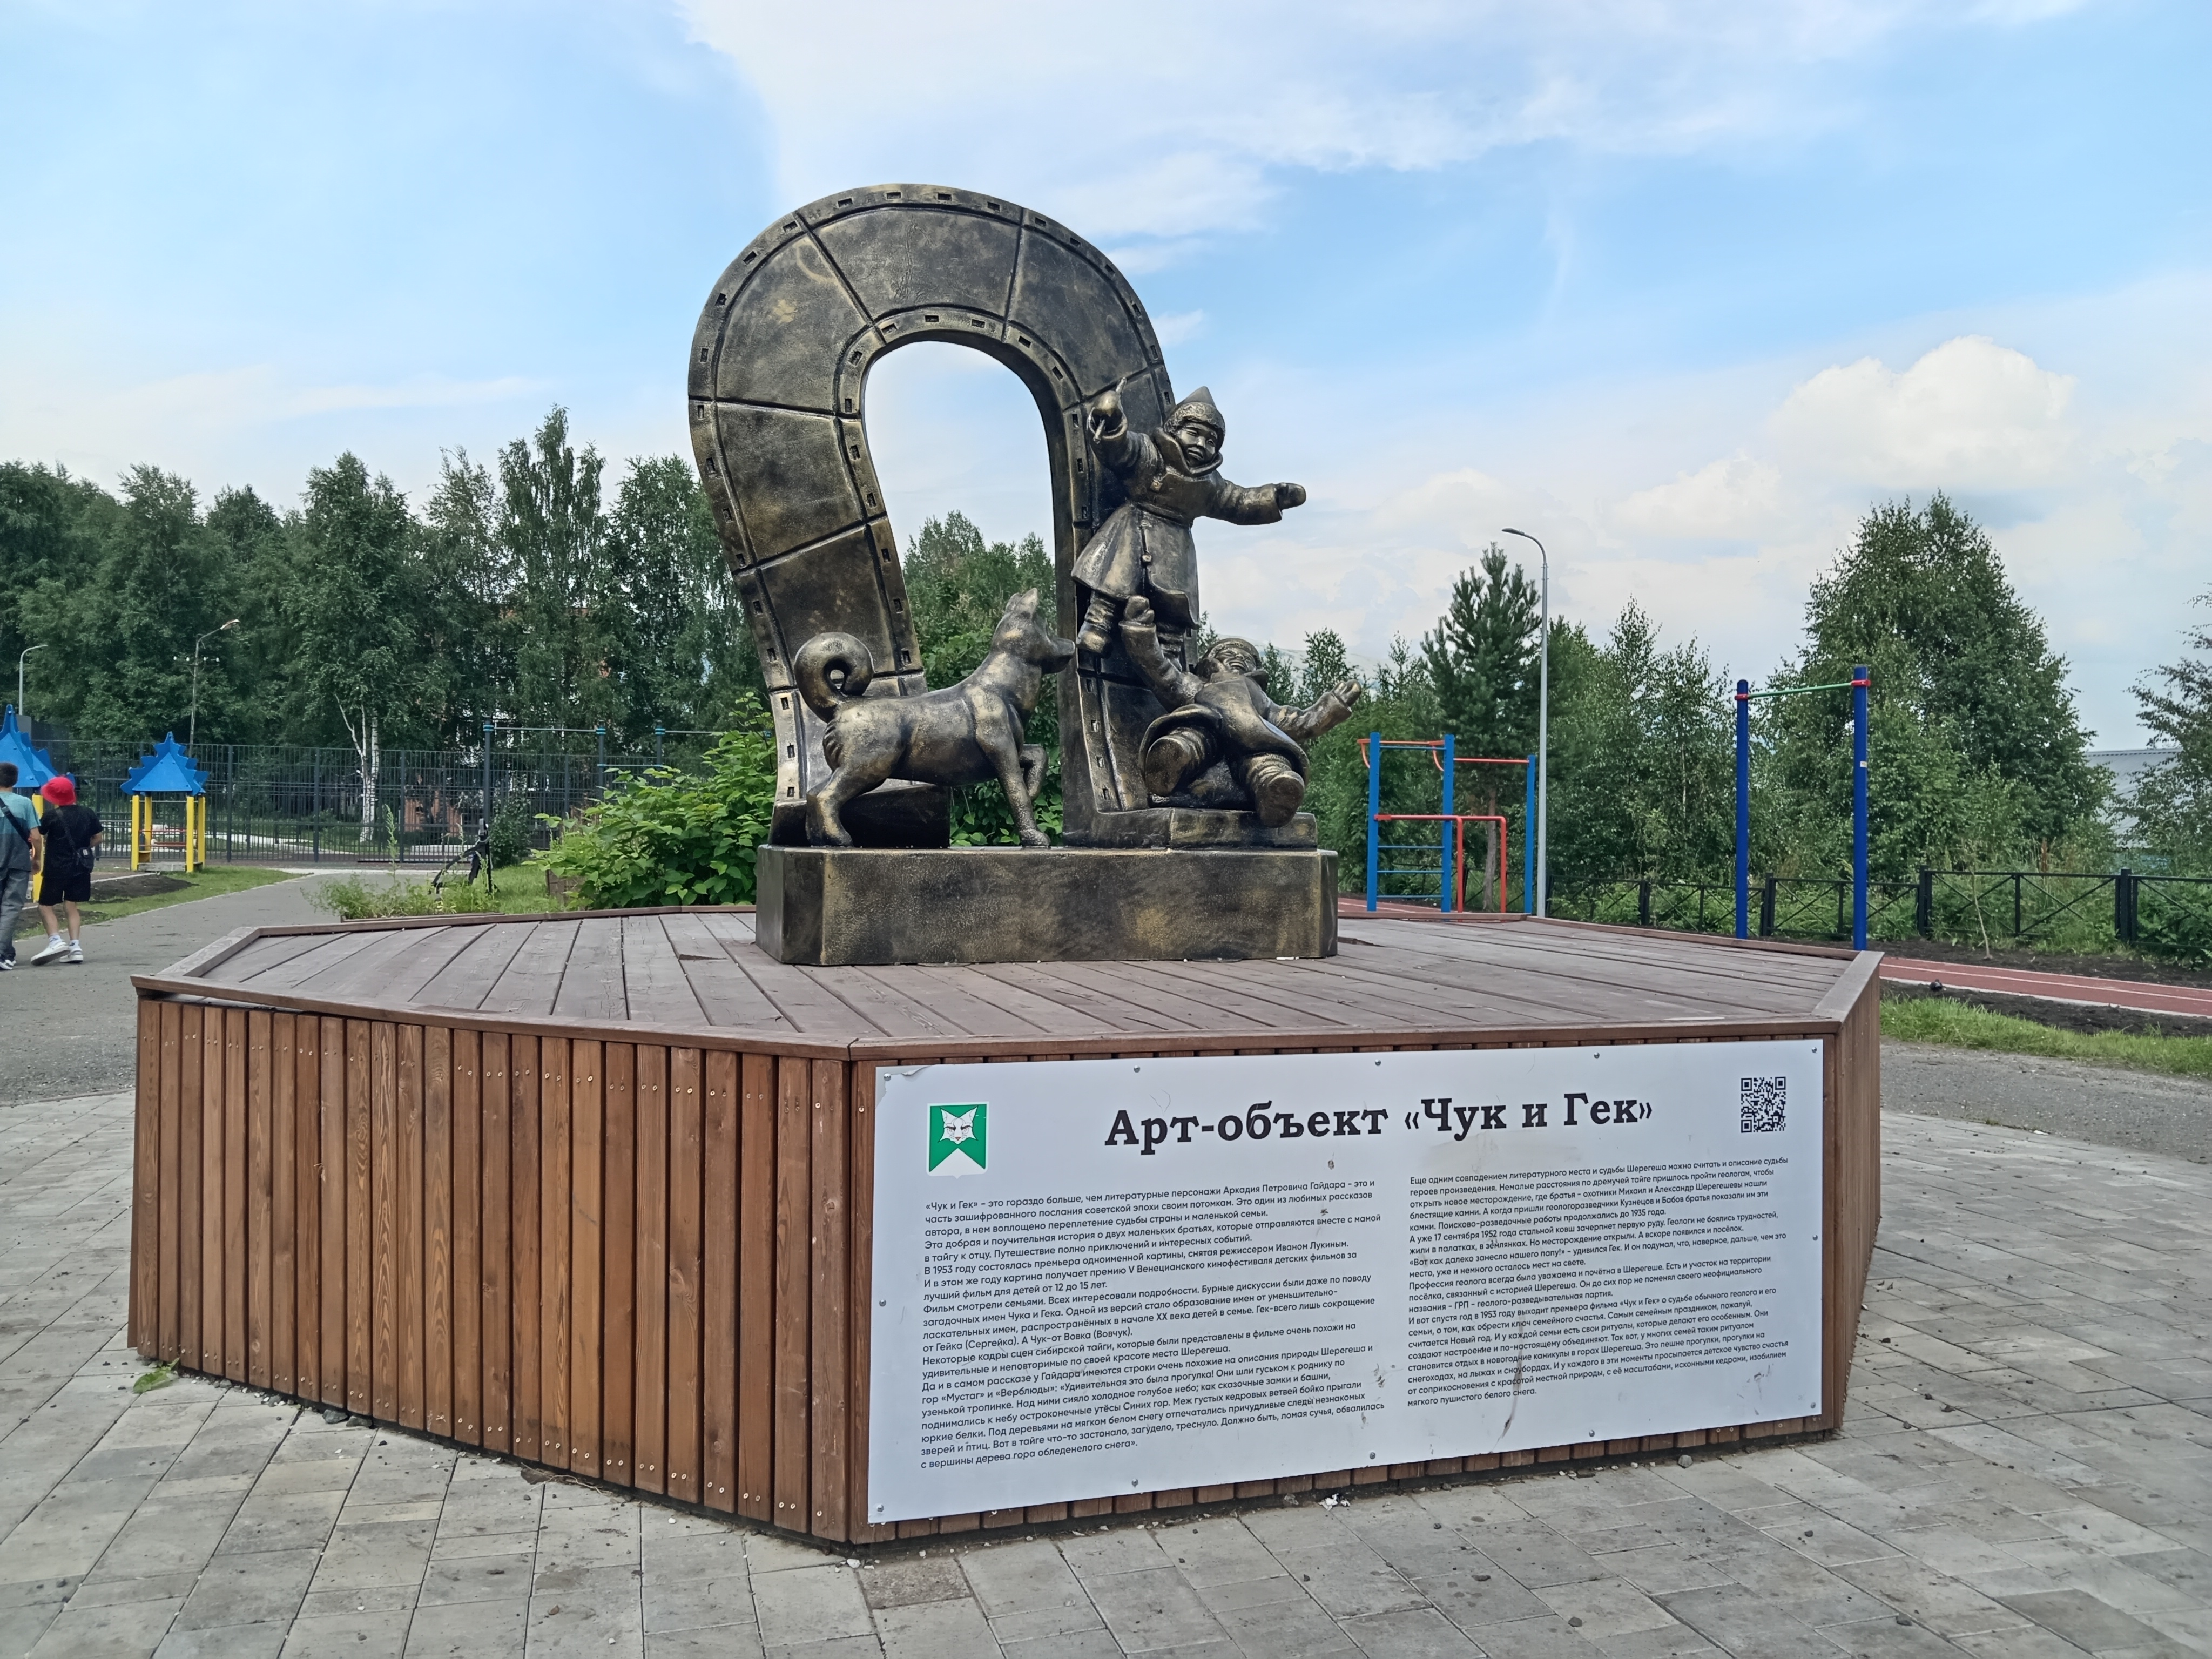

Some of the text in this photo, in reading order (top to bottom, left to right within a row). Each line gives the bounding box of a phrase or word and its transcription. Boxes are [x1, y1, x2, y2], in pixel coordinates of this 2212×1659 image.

[1105, 1093, 1652, 1155] Арт-объект «Чук и Гек»
[925, 1202, 948, 1212] «Чук
[959, 1200, 978, 1209] Гек»
[988, 1199, 1004, 1208] это
[1006, 1198, 1044, 1208] гораздо
[1046, 1195, 1083, 1204] больше,
[1104, 1191, 1170, 1202] литературные
[1171, 1188, 1222, 1199] персонажи
[1223, 1185, 1260, 1196] Аркадия
[1262, 1184, 1308, 1193] Петровича
[1310, 1181, 1346, 1190] Гайдара
[1410, 1189, 1438, 1198] героев
[1439, 1185, 1498, 1196] произведения.
[1499, 1183, 1535, 1191] Немалые
[1535, 1180, 1580, 1191] расстояния
[1592, 1176, 1629, 1187] дремучей
[1630, 1175, 1651, 1183] тайге
[1652, 1174, 1689, 1184] пришлось
[1690, 1171, 1716, 1181] пройти
[1717, 1170, 1752, 1178] геологам,
[1752, 1168, 1774, 1176] чтобы
[924, 1240, 943, 1249] Эта
[945, 1238, 981, 1250] добрая
[991, 1235, 1056, 1246] поучительная
[1057, 1232, 1095, 1242] история
[1105, 1230, 1126, 1239] двух
[1127, 1227, 1176, 1237] маленьких
[1177, 1225, 1215, 1236] братьях,
[1216, 1222, 1253, 1232] которые
[1255, 1219, 1315, 1230] отправляются
[1317, 1217, 1346, 1225] вместе
[1354, 1213, 1381, 1223] мамой
[1438, 1217, 1532, 1230] Поисково-разведочные
[1533, 1215, 1562, 1225] работы
[1563, 1212, 1618, 1223] продолжались
[1619, 1211, 1630, 1219] до
[1630, 1208, 1646, 1217] 1935
[1647, 1209, 1667, 1217] года.
[1438, 1244, 1478, 1253] палатках,
[1485, 1238, 1528, 1250] землянках.
[1529, 1238, 1540, 1246] Но
[1541, 1235, 1602, 1246] месторождение
[1603, 1233, 1637, 1242] открыли.
[1637, 1231, 1644, 1239] А
[1644, 1230, 1671, 1239] вскоре
[1672, 1228, 1705, 1236] появился
[1712, 1225, 1744, 1233] посёлок.
[924, 1240, 1349, 1275] В 1953 году состоялась премьера одноименной картины, снятая режиссером Иваном Лукиным.
[1408, 1280, 1454, 1291] Профессия
[1455, 1278, 1487, 1286] геолога
[1488, 1276, 1515, 1284] всегда
[1516, 1273, 1536, 1282] была
[1537, 1271, 1577, 1282] уважаема
[1584, 1267, 1616, 1276] почётна
[1623, 1264, 1664, 1274] Шерегеше.
[1665, 1262, 1682, 1270] Есть
[1688, 1260, 1717, 1270] участок
[1729, 1256, 1771, 1266] территории
[923, 1290, 960, 1303] лучший
[962, 1289, 992, 1300] фильм
[993, 1288, 1011, 1298] для
[1012, 1284, 1040, 1296] детей
[1054, 1282, 1064, 1292] 12
[1065, 1283, 1077, 1292] до
[1079, 1280, 1089, 1290] 15
[1090, 1281, 1108, 1289] лет.
[922, 1327, 990, 1340] ласкательных
[992, 1326, 1019, 1334] имен,
[1020, 1318, 1112, 1334] распространённых
[1121, 1314, 1154, 1324] начале
[1169, 1312, 1190, 1320] века
[1191, 1308, 1218, 1320] детей
[1226, 1307, 1254, 1316] семье.
[1256, 1304, 1297, 1313] Гек-всего
[1298, 1302, 1321, 1310] лишь
[1322, 1298, 1375, 1309] сокращение
[1408, 1328, 1434, 1337] семьи,
[1476, 1321, 1510, 1332] обрести
[1511, 1320, 1531, 1328] ключ
[1532, 1316, 1574, 1326] семейного
[1574, 1313, 1606, 1322] счастья.
[1607, 1311, 1634, 1319] Самым
[1635, 1307, 1673, 1317] семейным
[1674, 1304, 1719, 1315] праздником,
[1720, 1299, 1752, 1309] пожалуй,
[1407, 1351, 1442, 1360] создают
[1444, 1346, 1492, 1357] настроение
[1500, 1340, 1561, 1352] по-настоящему
[1562, 1336, 1609, 1346] объединяют.
[1610, 1333, 1624, 1341] Так
[1640, 1332, 1645, 1340] у
[1646, 1330, 1673, 1338] многих
[1673, 1326, 1696, 1336] семей
[1719, 1323, 1754, 1333] ритуалом
[922, 1396, 939, 1405] гор
[941, 1392, 984, 1404] «Мустаг»
[995, 1385, 1057, 1398] «Верблюды»:
[1060, 1379, 1127, 1392] «Удивительная
[1128, 1377, 1144, 1385] это
[1145, 1374, 1169, 1384] была
[1171, 1369, 1214, 1383] прогулка!
[1216, 1368, 1234, 1377] Они
[1255, 1365, 1289, 1375] гуськом
[1297, 1360, 1333, 1372] роднику
